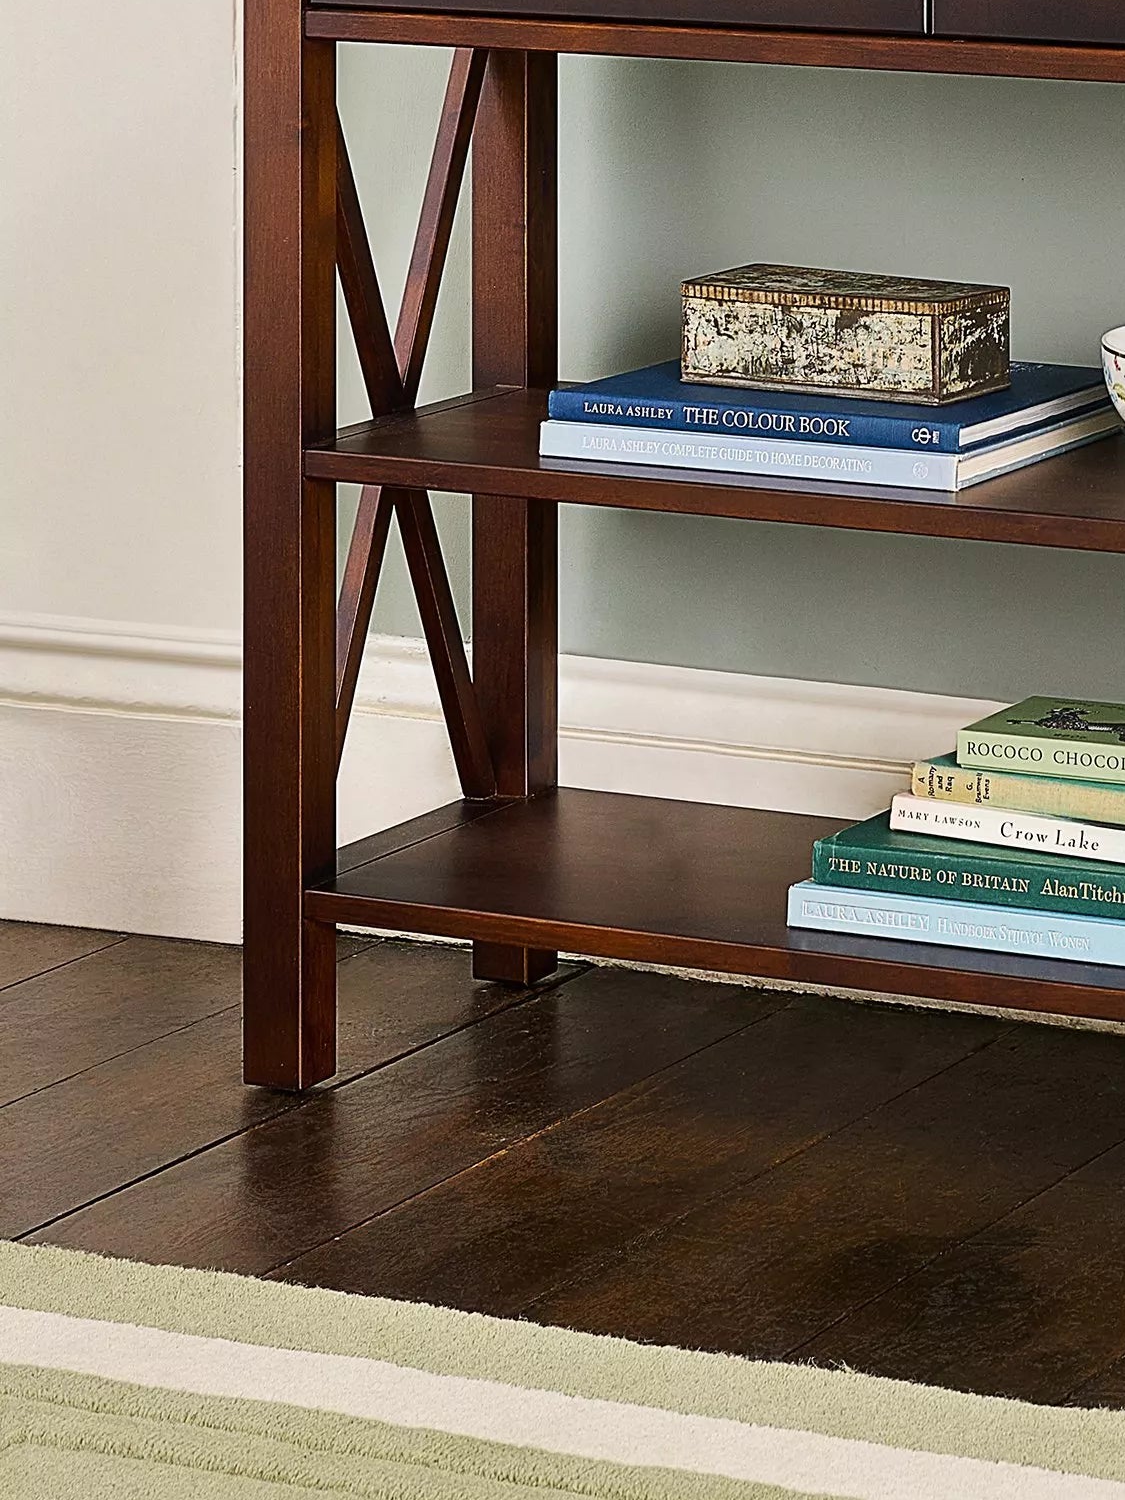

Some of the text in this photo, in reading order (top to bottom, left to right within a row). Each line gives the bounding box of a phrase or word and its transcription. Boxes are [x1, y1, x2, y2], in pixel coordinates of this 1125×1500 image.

[584, 402, 850, 437] LAURA ASHLEY THE COLOUR BOOK
[582, 436, 873, 472] LAURA ASHLEY COMPLETE GUIDE TO HOME DECORATING
[967, 741, 1043, 762] ROCOCO
[928, 765, 937, 797] Romany
[945, 776, 955, 792] Raq
[898, 809, 981, 829] MARY LAWSON
[999, 821, 1100, 852] Crow Lake
[829, 857, 1030, 892] THE NATURE OF BRITAIN
[803, 902, 928, 930] LAURA ASHLEY
